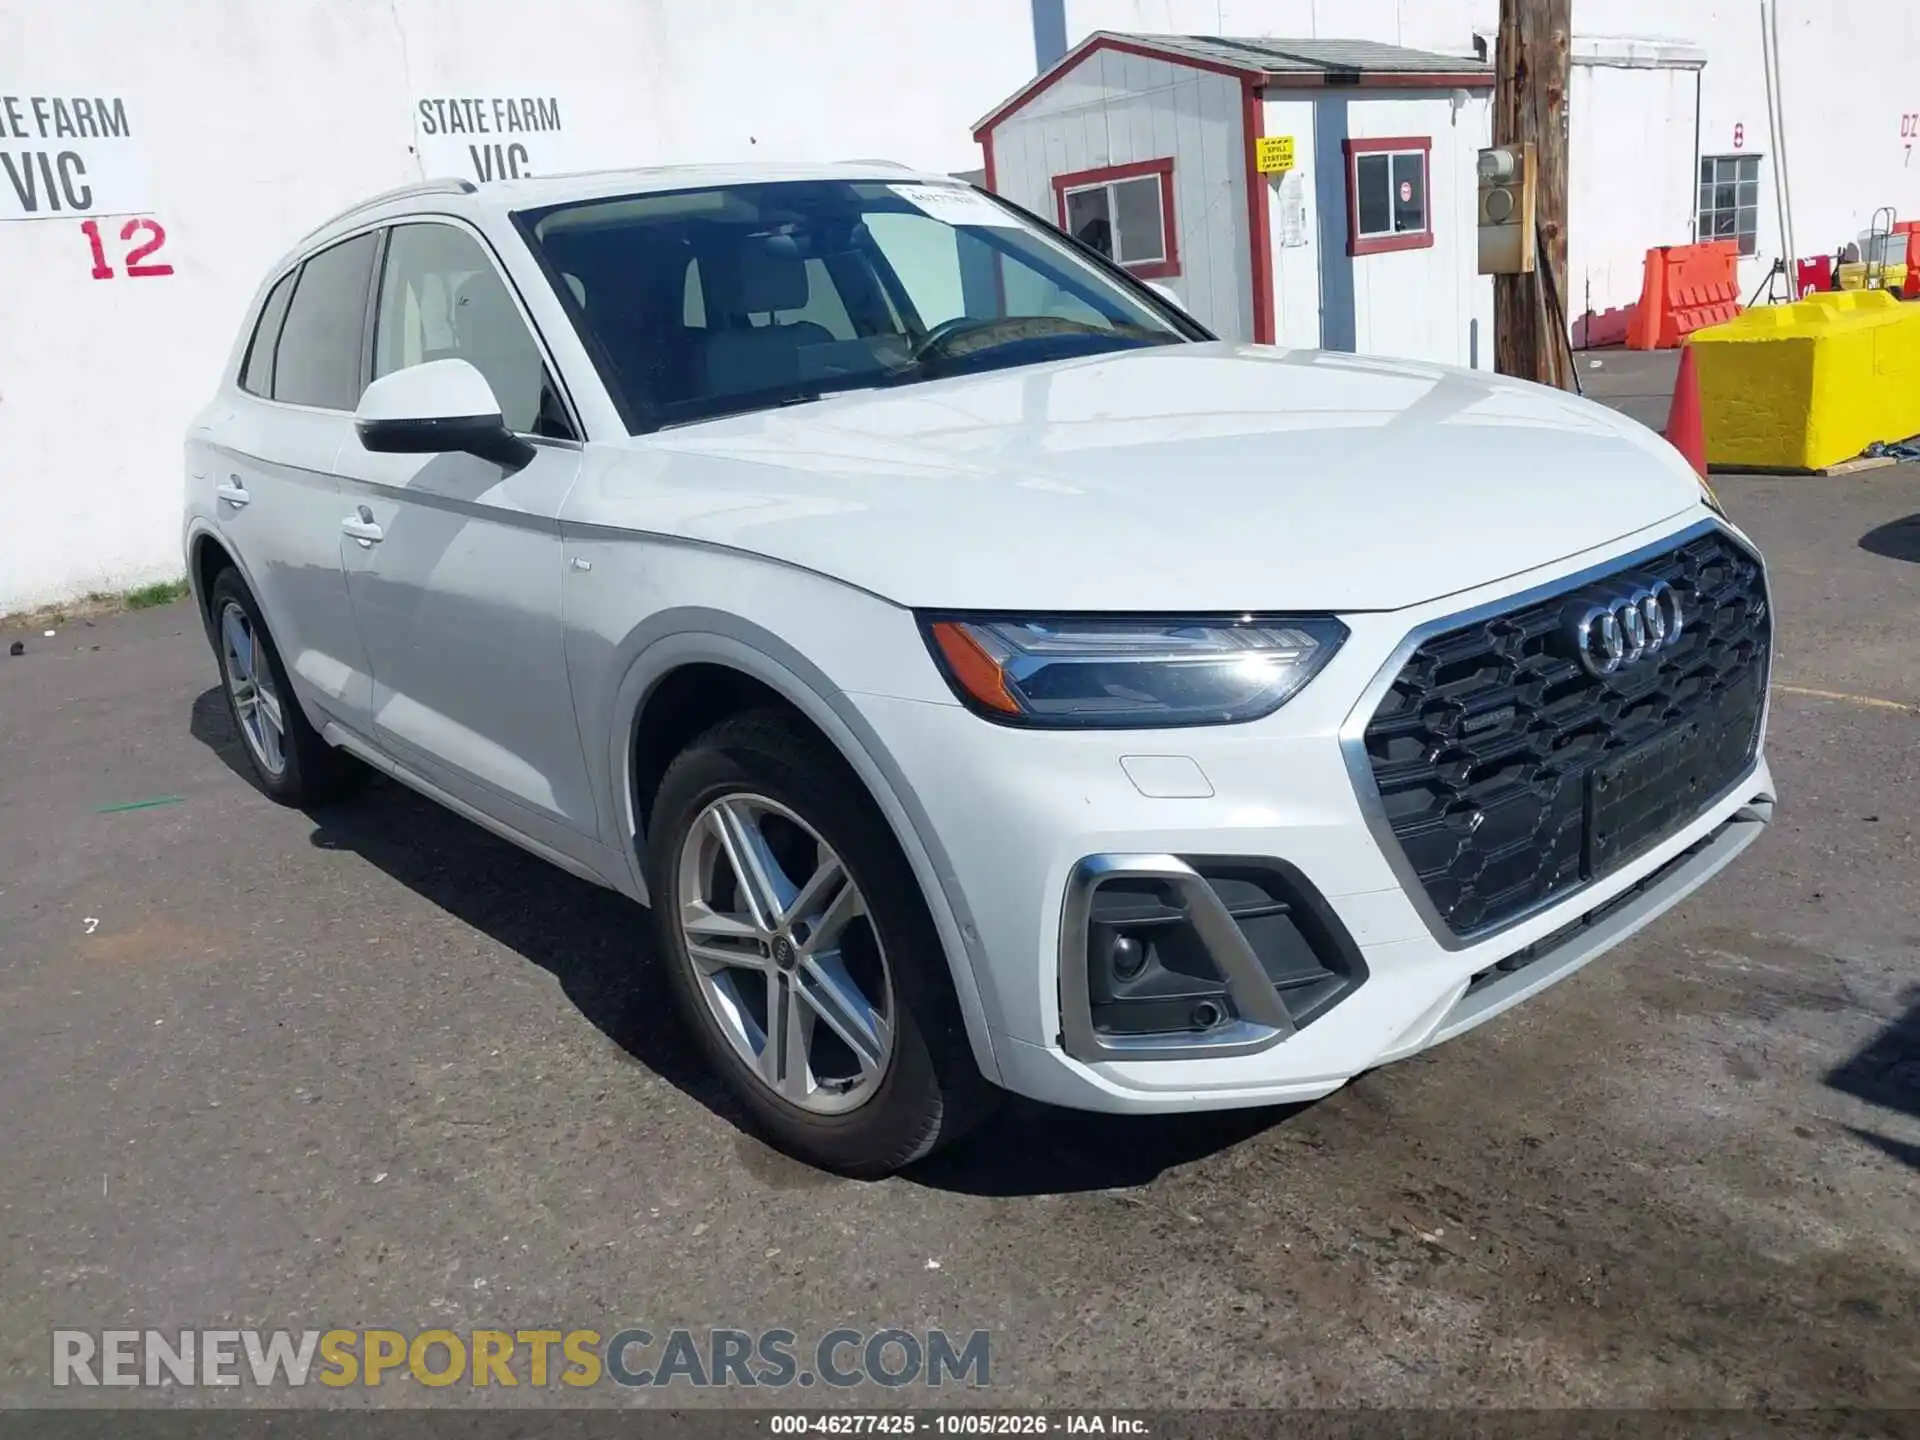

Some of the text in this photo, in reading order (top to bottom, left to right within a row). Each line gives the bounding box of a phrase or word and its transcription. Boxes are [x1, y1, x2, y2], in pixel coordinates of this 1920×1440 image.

[30, 97, 130, 138] FARM
[418, 97, 561, 134] STATE FARM
[1734, 122, 1744, 148] 8
[468, 143, 531, 183] VIC
[1263, 154, 1293, 162] STATION
[0, 151, 93, 212] VIC
[81, 219, 174, 279] 12
